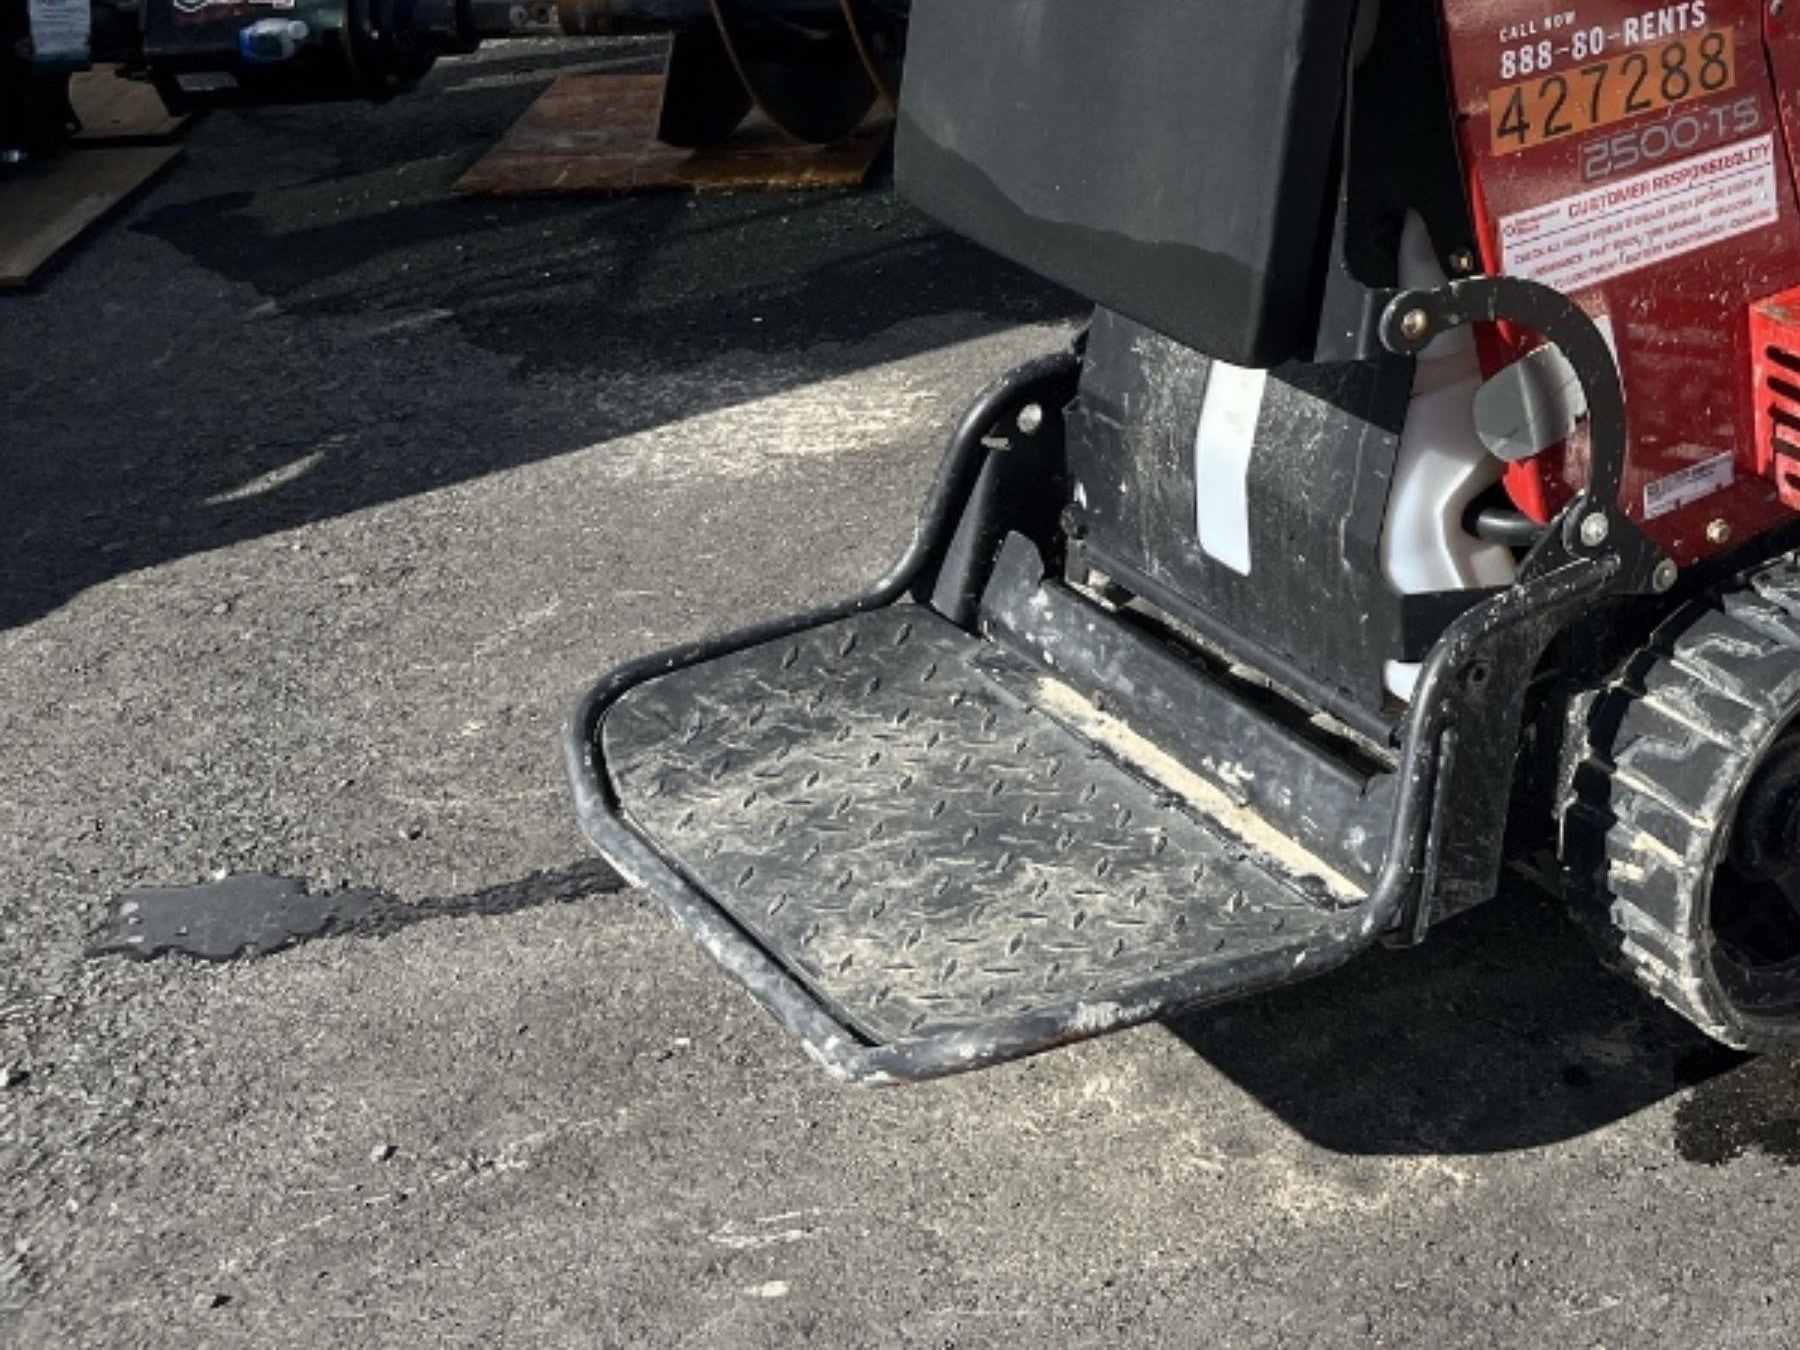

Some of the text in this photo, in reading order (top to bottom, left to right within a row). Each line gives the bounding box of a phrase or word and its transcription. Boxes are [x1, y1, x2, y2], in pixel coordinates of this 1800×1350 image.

[1500, 10, 1577, 42] CALL NOW
[1501, 0, 1706, 79] 888-80-RENTS
[1496, 32, 1728, 144] 427288
[1568, 177, 1651, 219] CUSTOMER
